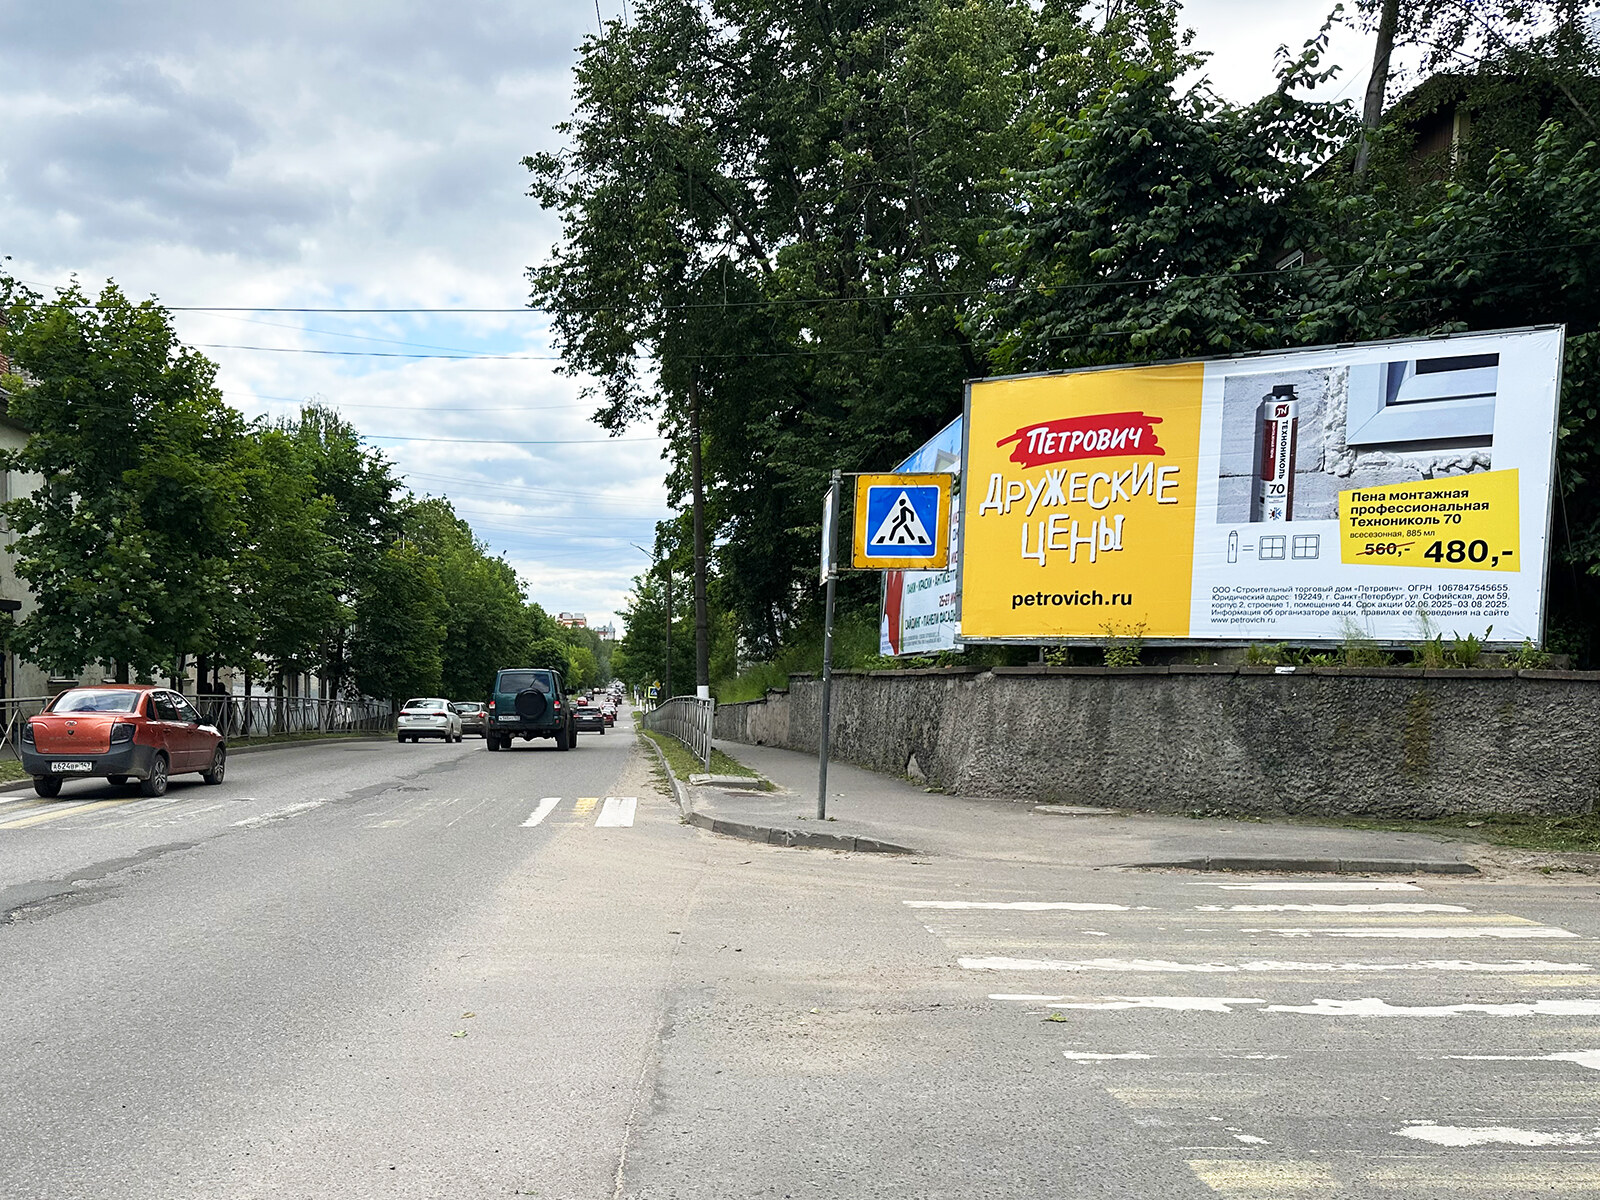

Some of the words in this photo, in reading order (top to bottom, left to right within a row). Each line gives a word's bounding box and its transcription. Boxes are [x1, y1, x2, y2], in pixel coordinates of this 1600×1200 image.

[1026, 426, 1143, 455] ПЕТРОВИЧ
[1278, 419, 1289, 480] ТЕХНОНИКОЛЬ
[979, 462, 1180, 517] ДРУЖЕСКИЕ
[1268, 483, 1286, 495] 70
[1351, 492, 1386, 502] Пена
[1389, 490, 1469, 501] монтажная
[1350, 502, 1489, 516] профессиональная
[1350, 515, 1440, 527] Технониколь
[1444, 514, 1462, 524] 70
[1021, 514, 1126, 568] ЦЕНЫ
[1349, 531, 1405, 539] всесезонная,
[1424, 540, 1513, 567] 480,-
[1212, 586, 1231, 594] ООО
[1294, 586, 1333, 595] торговый
[1407, 584, 1432, 592] ОГРН
[1012, 591, 1132, 609] petrovich.ru
[1211, 594, 1265, 602] Юридический
[1294, 593, 1324, 601] 192249,
[1333, 592, 1407, 601] Санкт-Петербург,
[1422, 592, 1475, 601] Софийская,
[1496, 592, 1510, 601] 59,
[1211, 601, 1238, 609] корпус
[1247, 601, 1285, 609] строение
[1293, 601, 1340, 609] помещение
[1355, 600, 1375, 609] Срок
[1378, 601, 1403, 609] акции
[1211, 608, 1261, 616] Информация
[1262, 608, 1274, 616] об
[1275, 609, 1330, 617] организаторе
[1331, 609, 1358, 617] акции,
[1360, 609, 1400, 617] правилах
[1415, 609, 1468, 617] проведения
